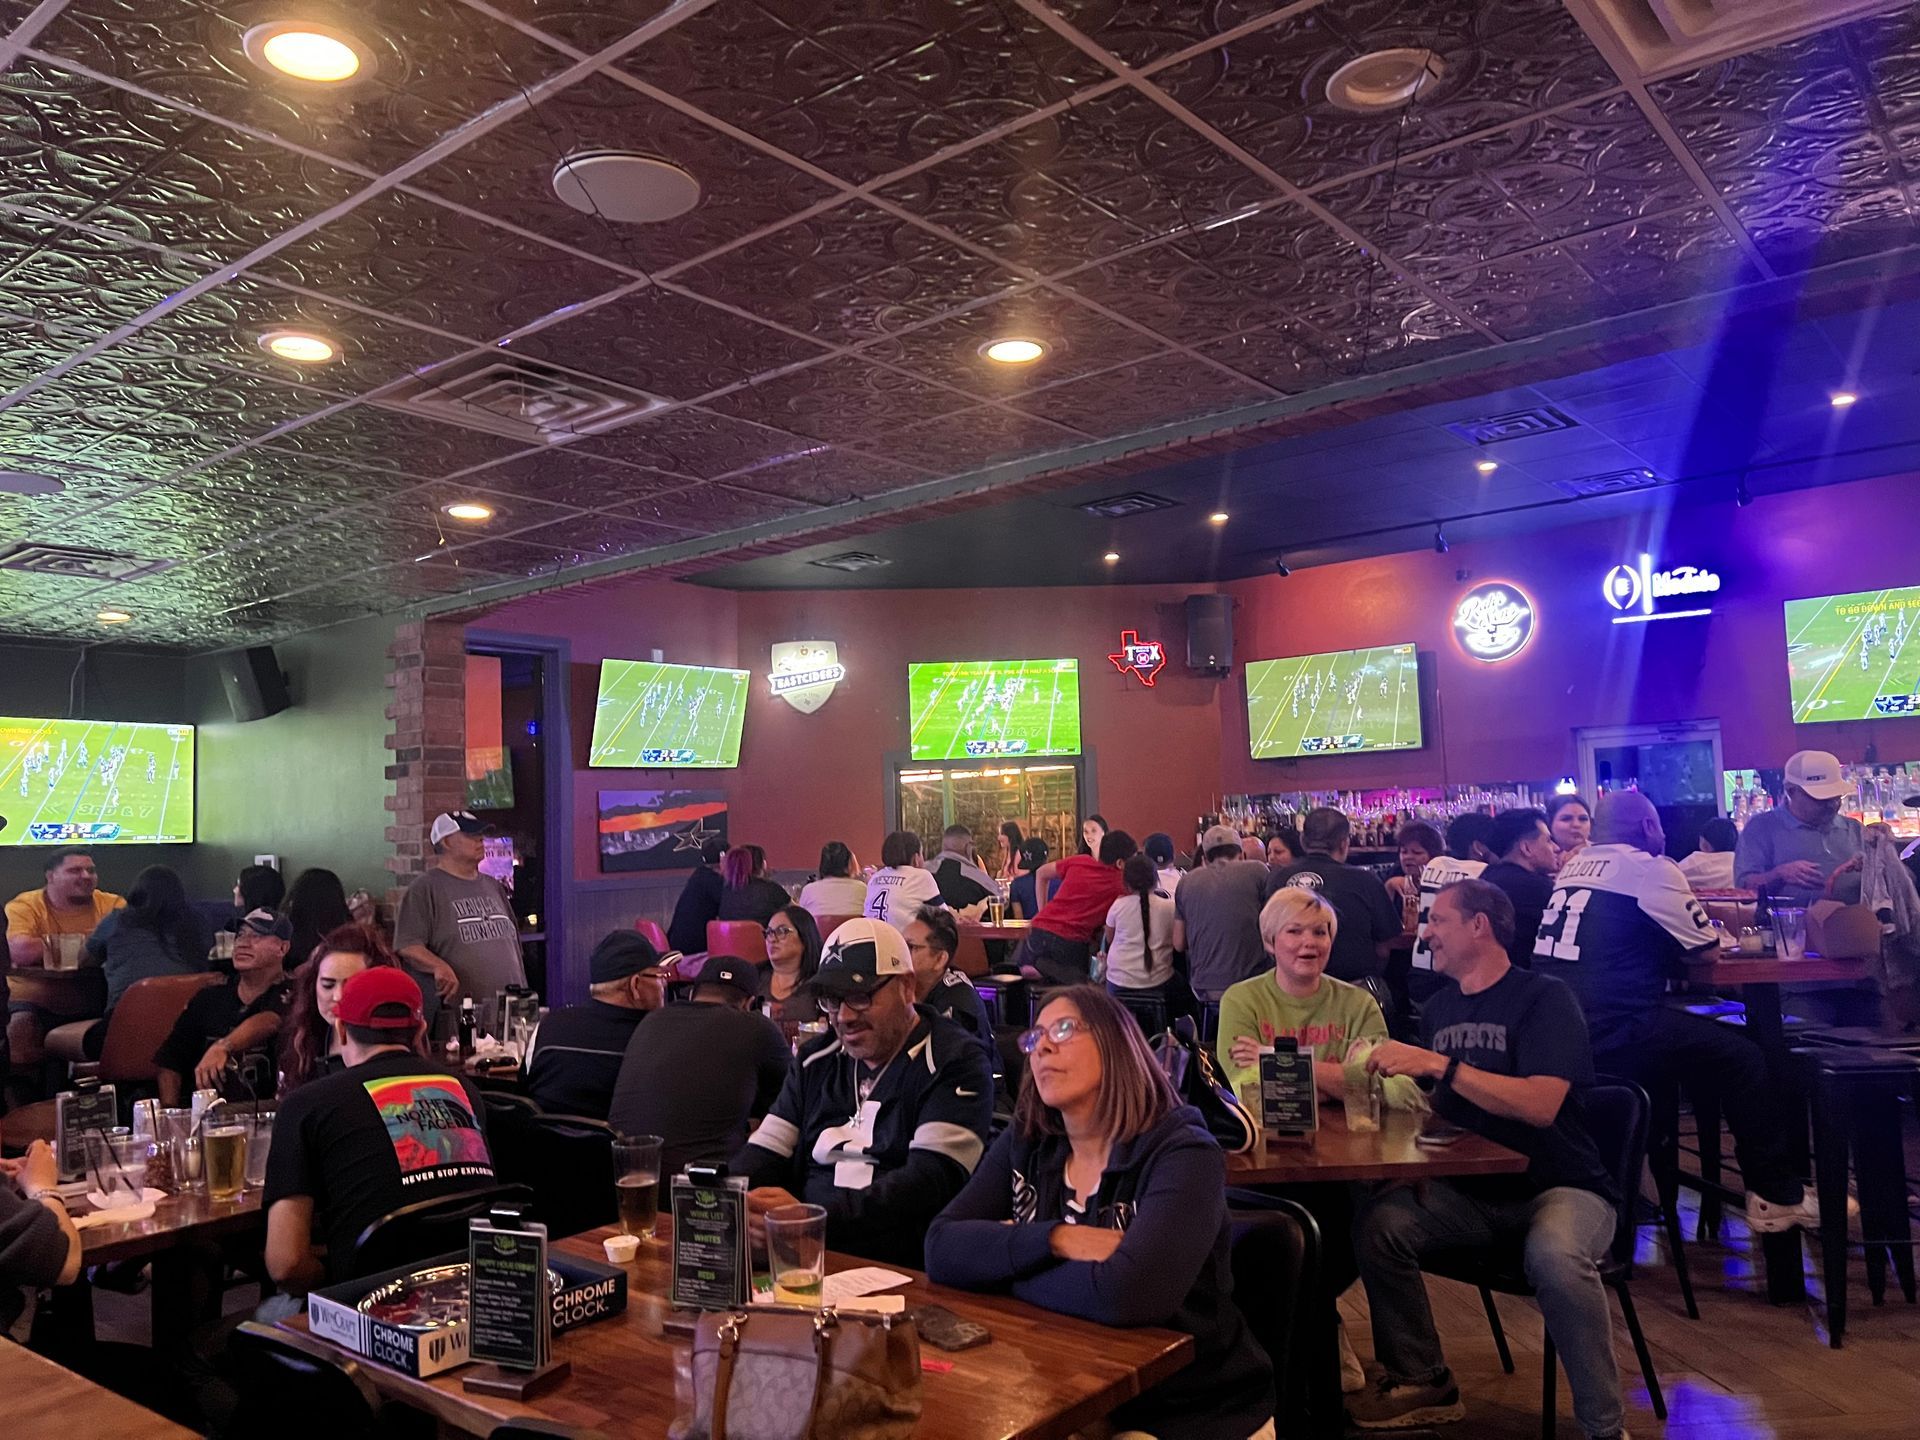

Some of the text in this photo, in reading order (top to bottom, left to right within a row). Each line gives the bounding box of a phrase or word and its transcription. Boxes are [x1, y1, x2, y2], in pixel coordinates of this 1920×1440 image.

[871, 889, 890, 923] 4
[1533, 889, 1593, 961] 21
[1432, 1022, 1507, 1053] COWBOYS
[396, 1107, 454, 1124] NORTH
[419, 1098, 449, 1112] THE
[418, 1117, 457, 1132] FACE
[402, 1171, 435, 1186] NEVER
[437, 1167, 459, 1179] STOP
[553, 1279, 616, 1311] CHROME
[552, 1298, 606, 1328] CLOCK
[373, 1324, 414, 1353] CHROME
[373, 1342, 409, 1368] CLOCK
